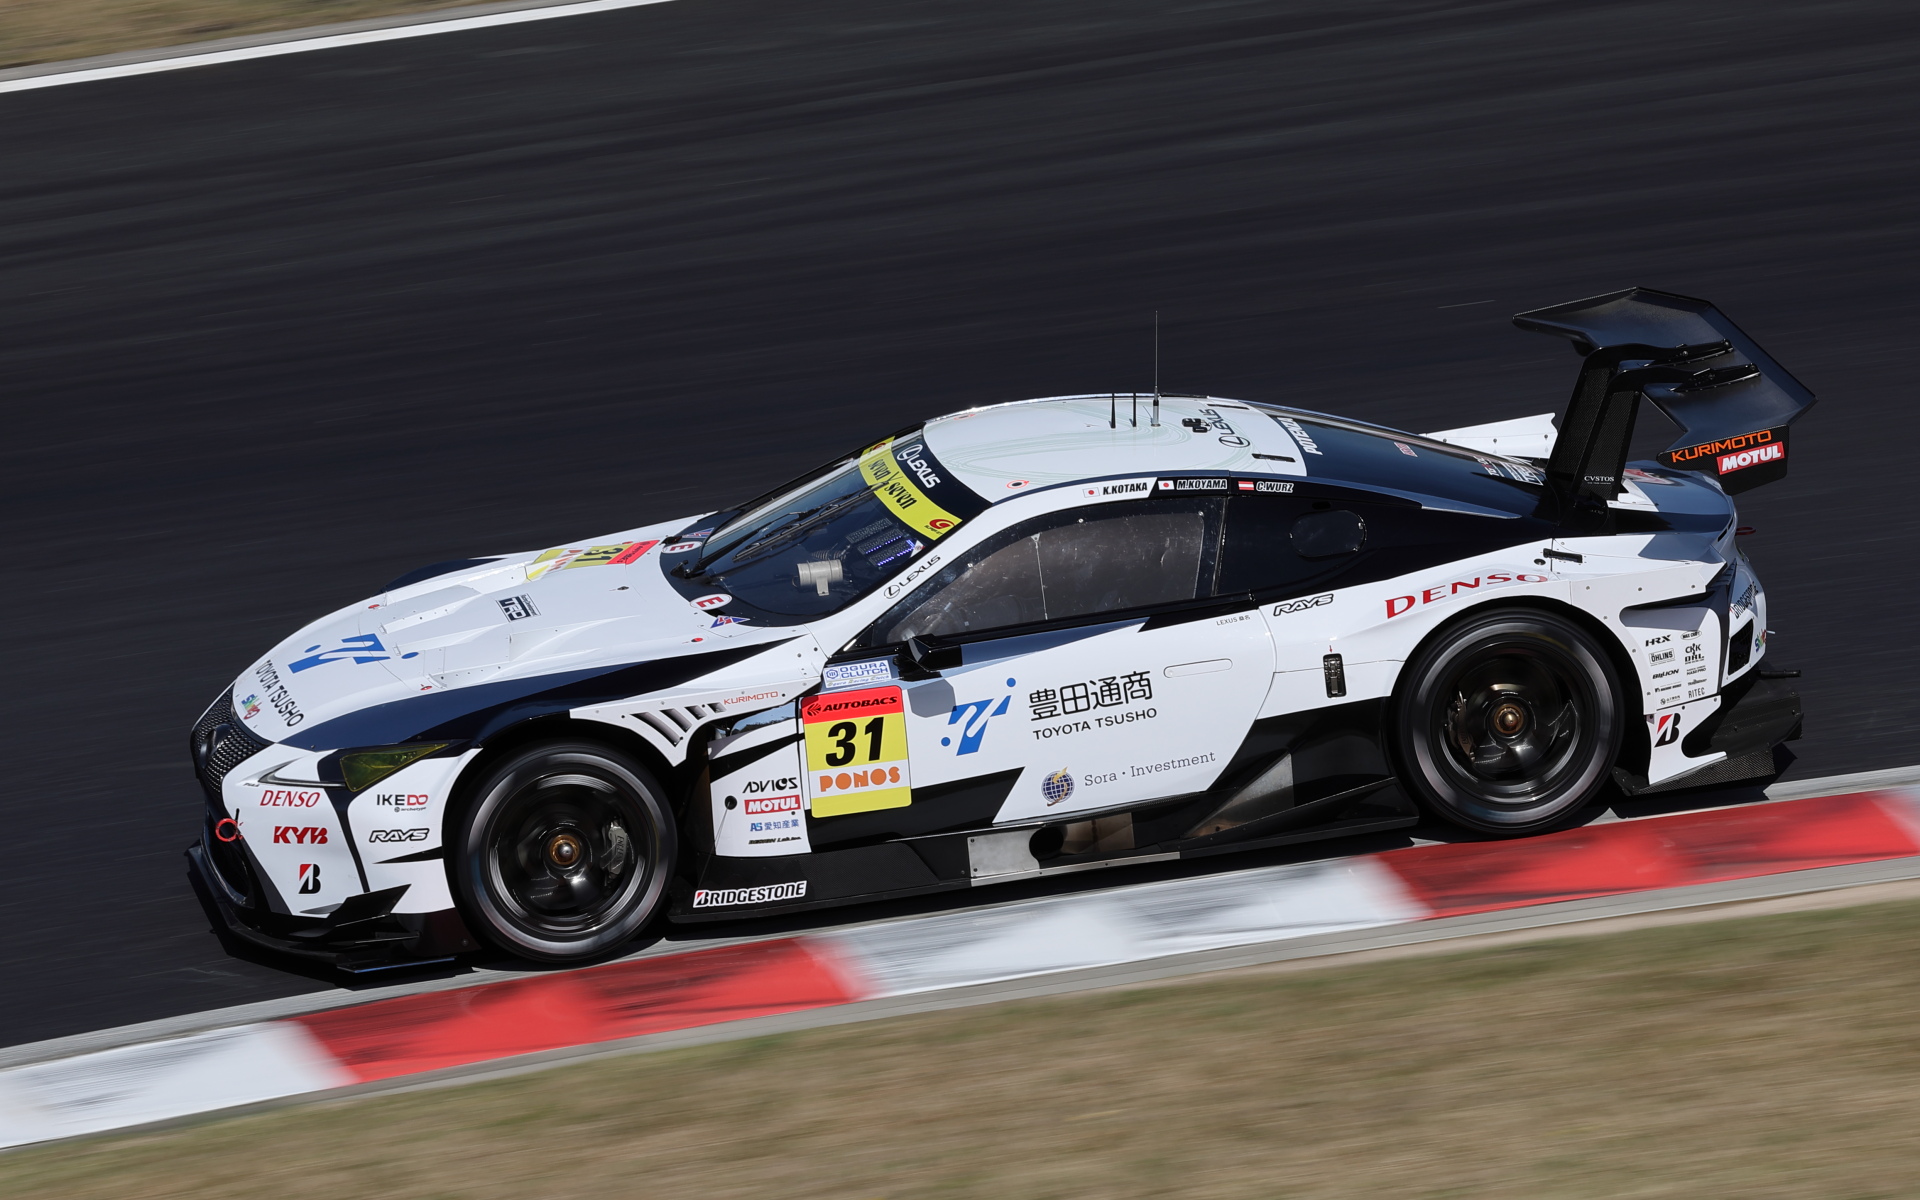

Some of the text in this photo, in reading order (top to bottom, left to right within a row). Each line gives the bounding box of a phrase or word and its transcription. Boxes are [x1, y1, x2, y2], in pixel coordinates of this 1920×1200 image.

[1671, 430, 1772, 462] KURIMOTO
[1721, 444, 1782, 472] MOTUL
[906, 454, 942, 489] LEXUS
[1102, 482, 1148, 496] K.KOTAKA
[1176, 478, 1228, 490] M.KOYAMA
[1255, 482, 1294, 493] C.WURZ
[884, 481, 918, 510] seven
[899, 554, 941, 587] LEXUS
[1273, 593, 1334, 616] RAYS
[1384, 572, 1549, 619] DENSO
[1216, 617, 1238, 626] LEXUS
[1645, 634, 1671, 647] HRX
[840, 662, 887, 673] OGURA
[841, 668, 889, 679] CLUTCH
[255, 659, 305, 728] TOYOTA TSUSHO
[723, 691, 779, 705] KURIMOTO
[1028, 670, 1154, 722] 豊田通商
[822, 696, 898, 713] AUTOBACS
[1033, 707, 1158, 741] TOYOTA TSUSHO
[825, 716, 885, 767] 31
[1084, 751, 1217, 787] Sora Investment
[742, 776, 798, 794] ADVICS
[819, 766, 901, 792] PONOS
[259, 790, 321, 808] DENSO
[376, 794, 429, 806] IKEDO
[747, 796, 799, 813] MOTUL
[273, 825, 329, 844] KYB
[368, 827, 430, 843] RAYS
[694, 881, 807, 906] BRIDGESTONE
